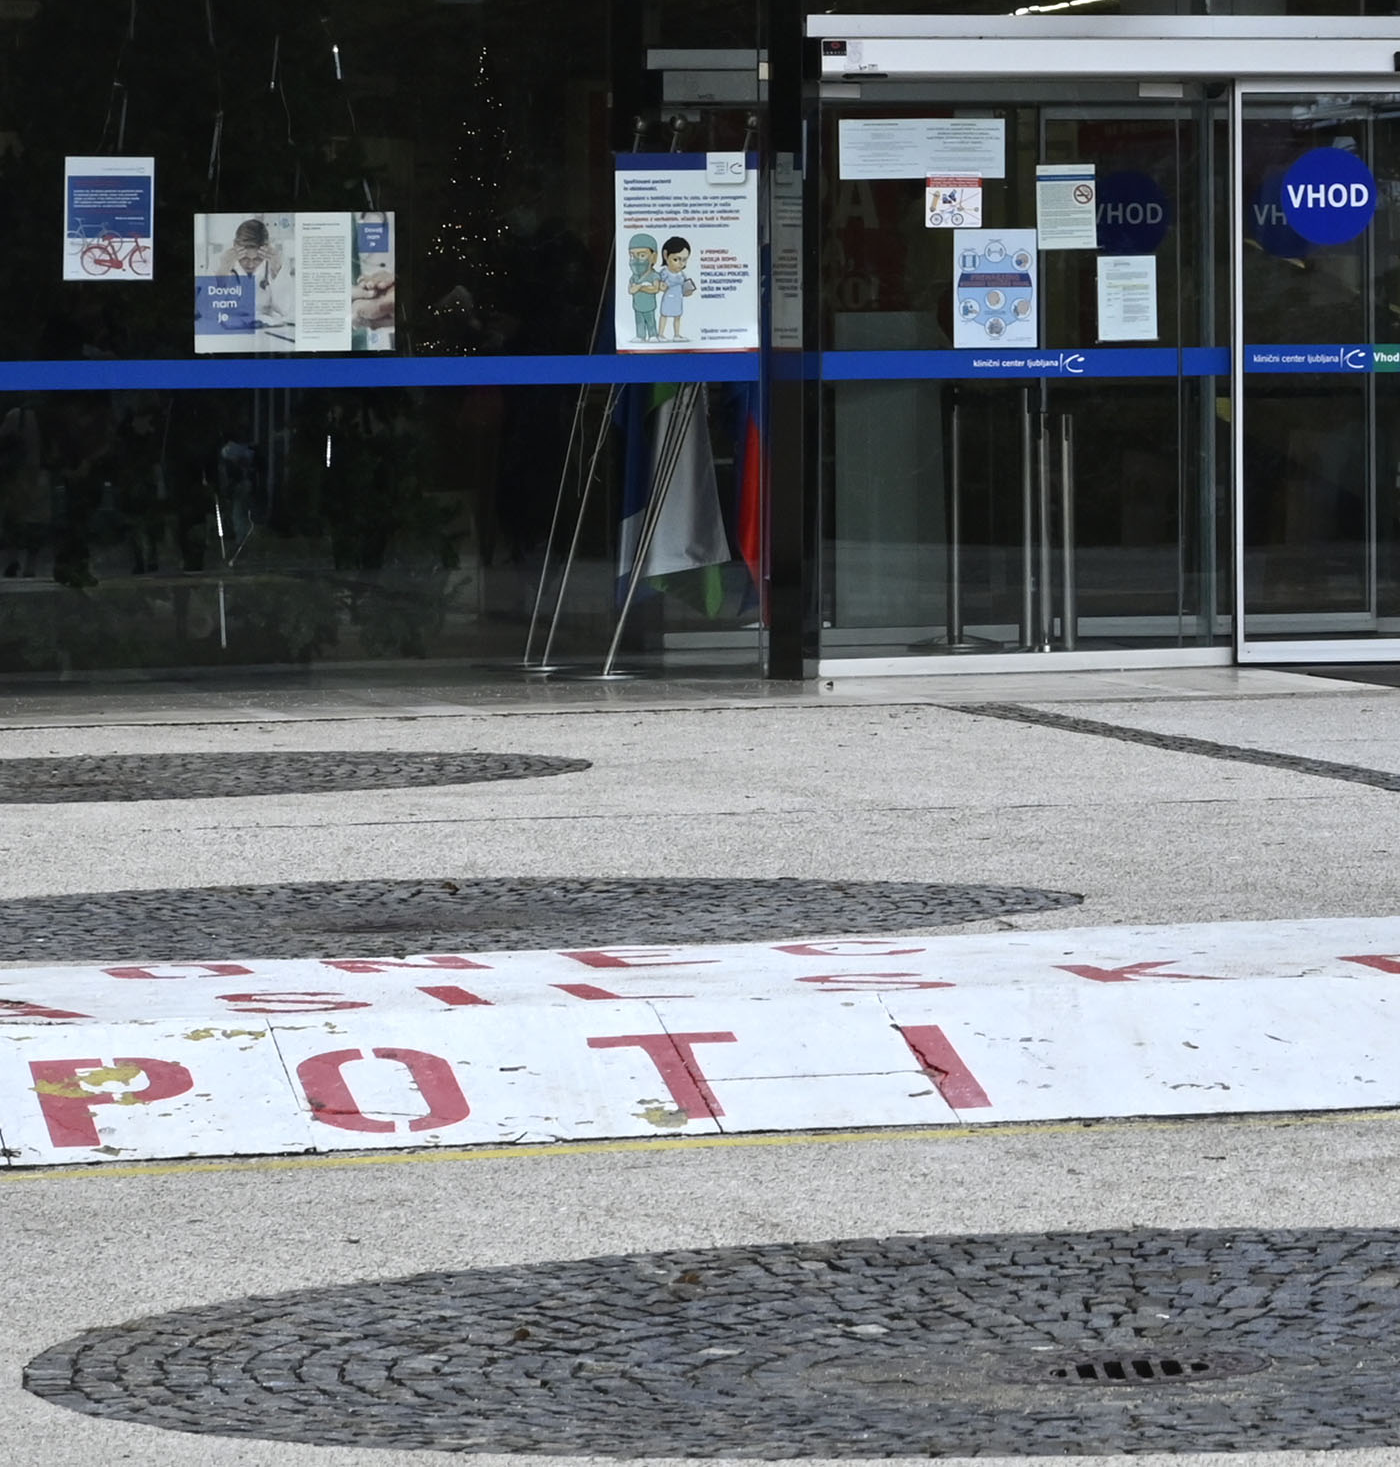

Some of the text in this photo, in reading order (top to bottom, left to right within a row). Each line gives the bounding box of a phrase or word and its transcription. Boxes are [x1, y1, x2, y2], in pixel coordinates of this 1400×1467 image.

[1287, 183, 1369, 209] VHOD
[208, 285, 242, 297] Dovolj
[212, 299, 238, 309] nam
[217, 312, 229, 323] je
[1253, 353, 1339, 364] klinični center ljubljana
[1373, 351, 1400, 362] Vhod
[973, 358, 1059, 369] klinični center ljubljana
[28, 1024, 992, 1148] POTI
